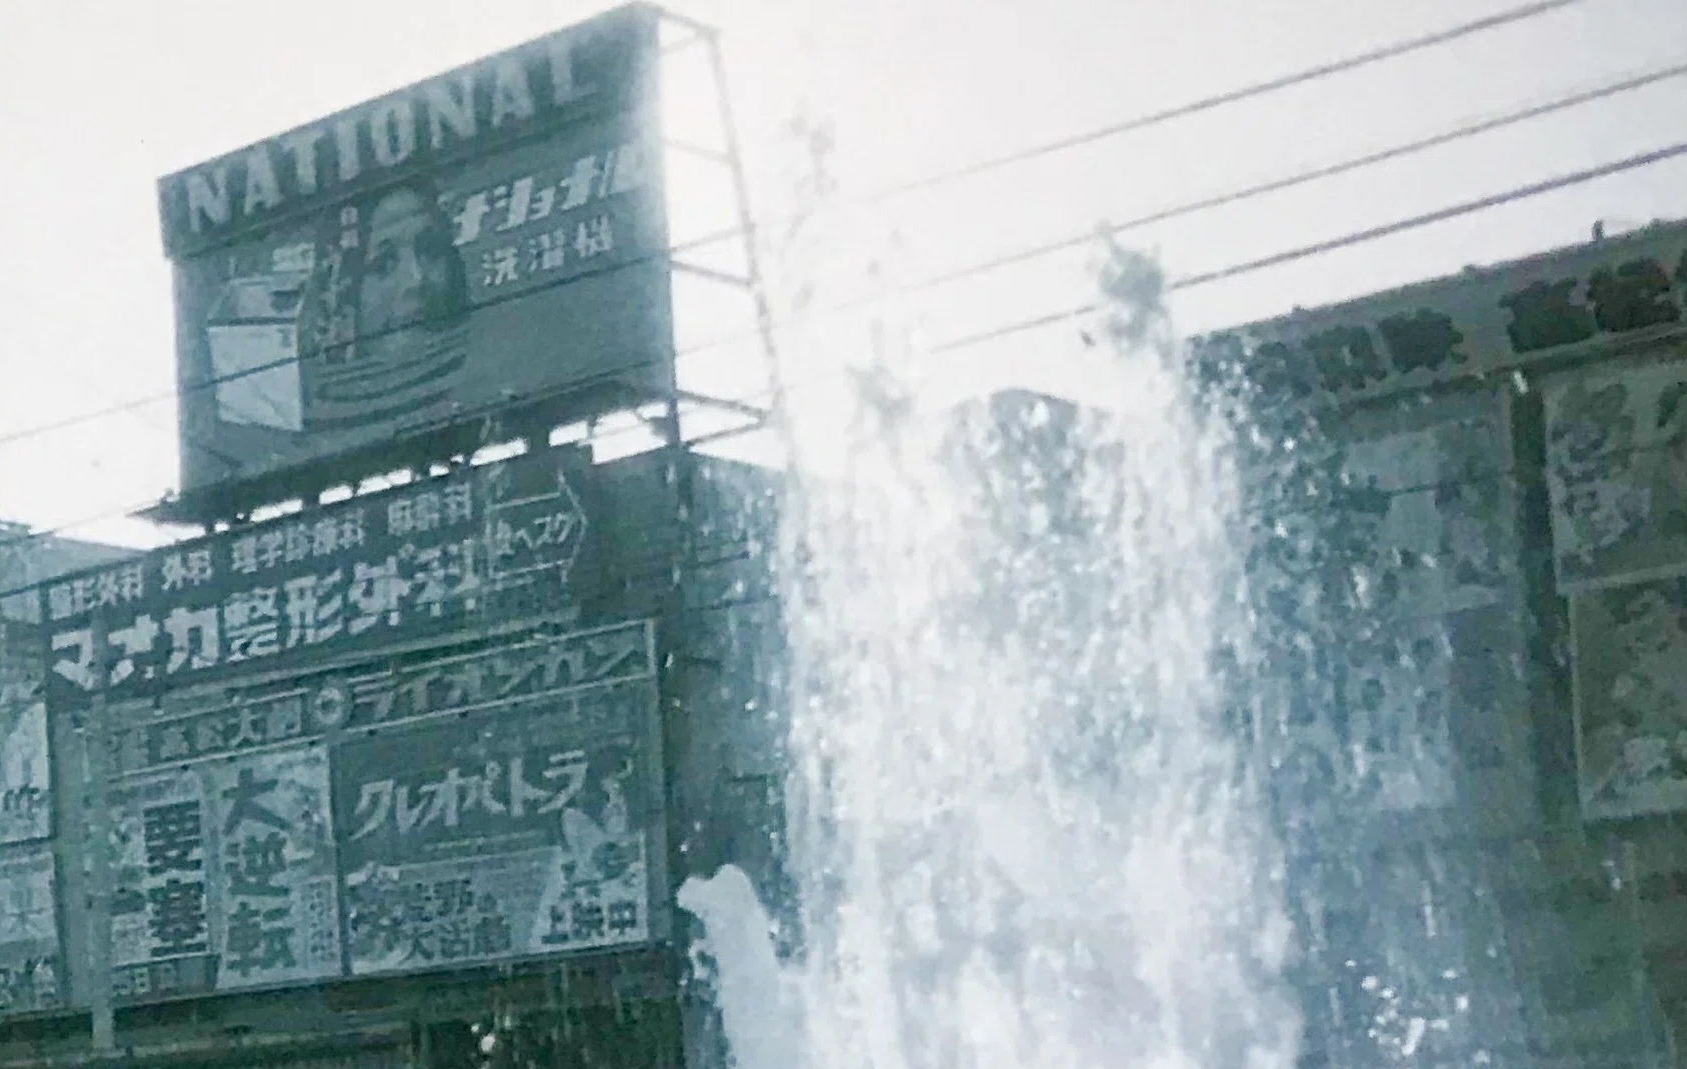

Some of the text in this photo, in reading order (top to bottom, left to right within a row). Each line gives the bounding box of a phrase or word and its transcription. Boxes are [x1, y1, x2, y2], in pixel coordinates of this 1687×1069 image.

[186, 38, 603, 235] NATIONAL
[221, 767, 298, 978] 大逆転
[349, 749, 589, 843] クレオパトラ
